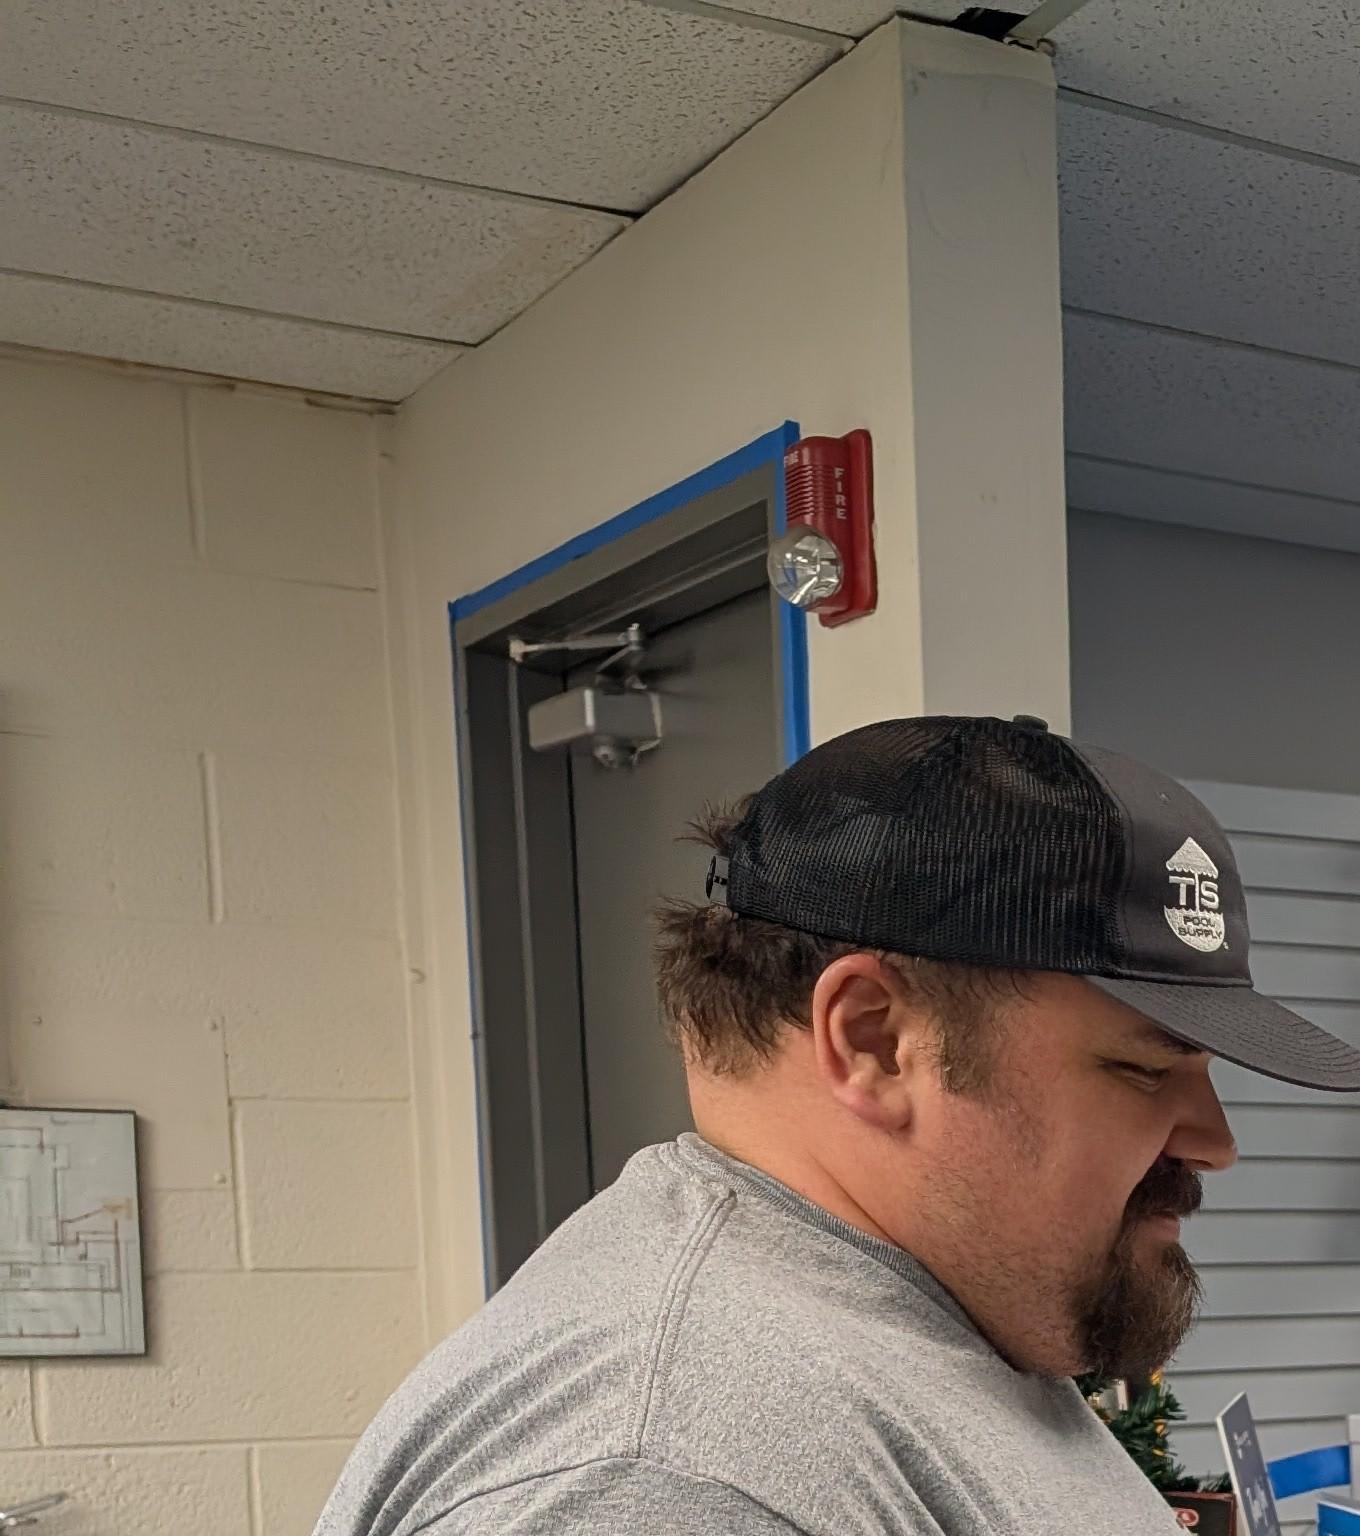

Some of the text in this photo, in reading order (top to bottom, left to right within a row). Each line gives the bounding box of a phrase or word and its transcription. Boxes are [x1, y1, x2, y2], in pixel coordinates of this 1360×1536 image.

[834, 467, 847, 520] FIRE
[1169, 876, 1219, 909] TS
[1183, 916, 1216, 927] POOL
[1178, 927, 1222, 940] SUPPLY
